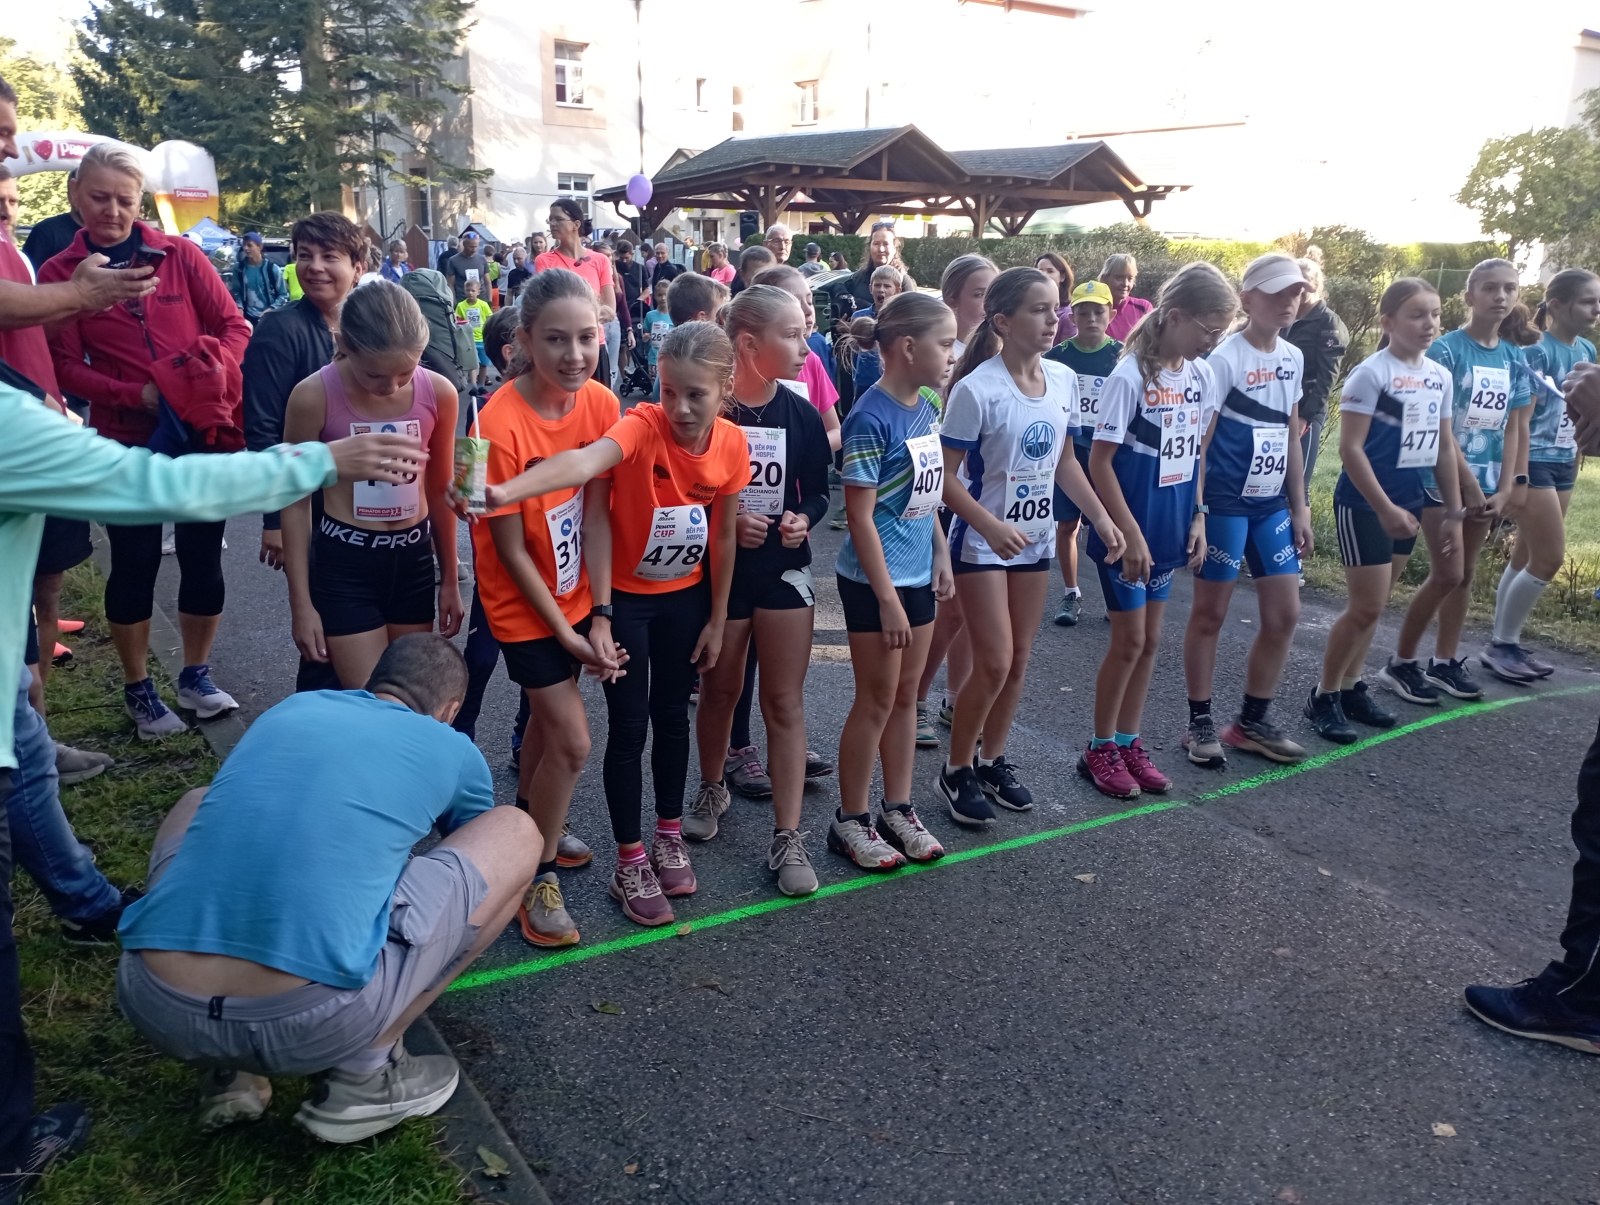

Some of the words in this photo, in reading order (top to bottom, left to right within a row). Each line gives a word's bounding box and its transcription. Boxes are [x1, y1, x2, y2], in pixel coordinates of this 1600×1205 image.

[1246, 366, 1295, 386] OlfinCar
[1144, 386, 1201, 406] OlfinCa
[1472, 390, 1507, 410] 428
[1162, 434, 1195, 460] 431
[1401, 430, 1438, 450] 477
[747, 460, 782, 488] 20
[1250, 455, 1286, 476] 394
[914, 466, 942, 496] 407
[1006, 498, 1050, 522] 408
[320, 516, 369, 546] NIKE
[371, 528, 422, 548] PRO
[1275, 517, 1292, 535] ATE
[642, 544, 704, 566] 478
[1150, 568, 1174, 588] Olfin
